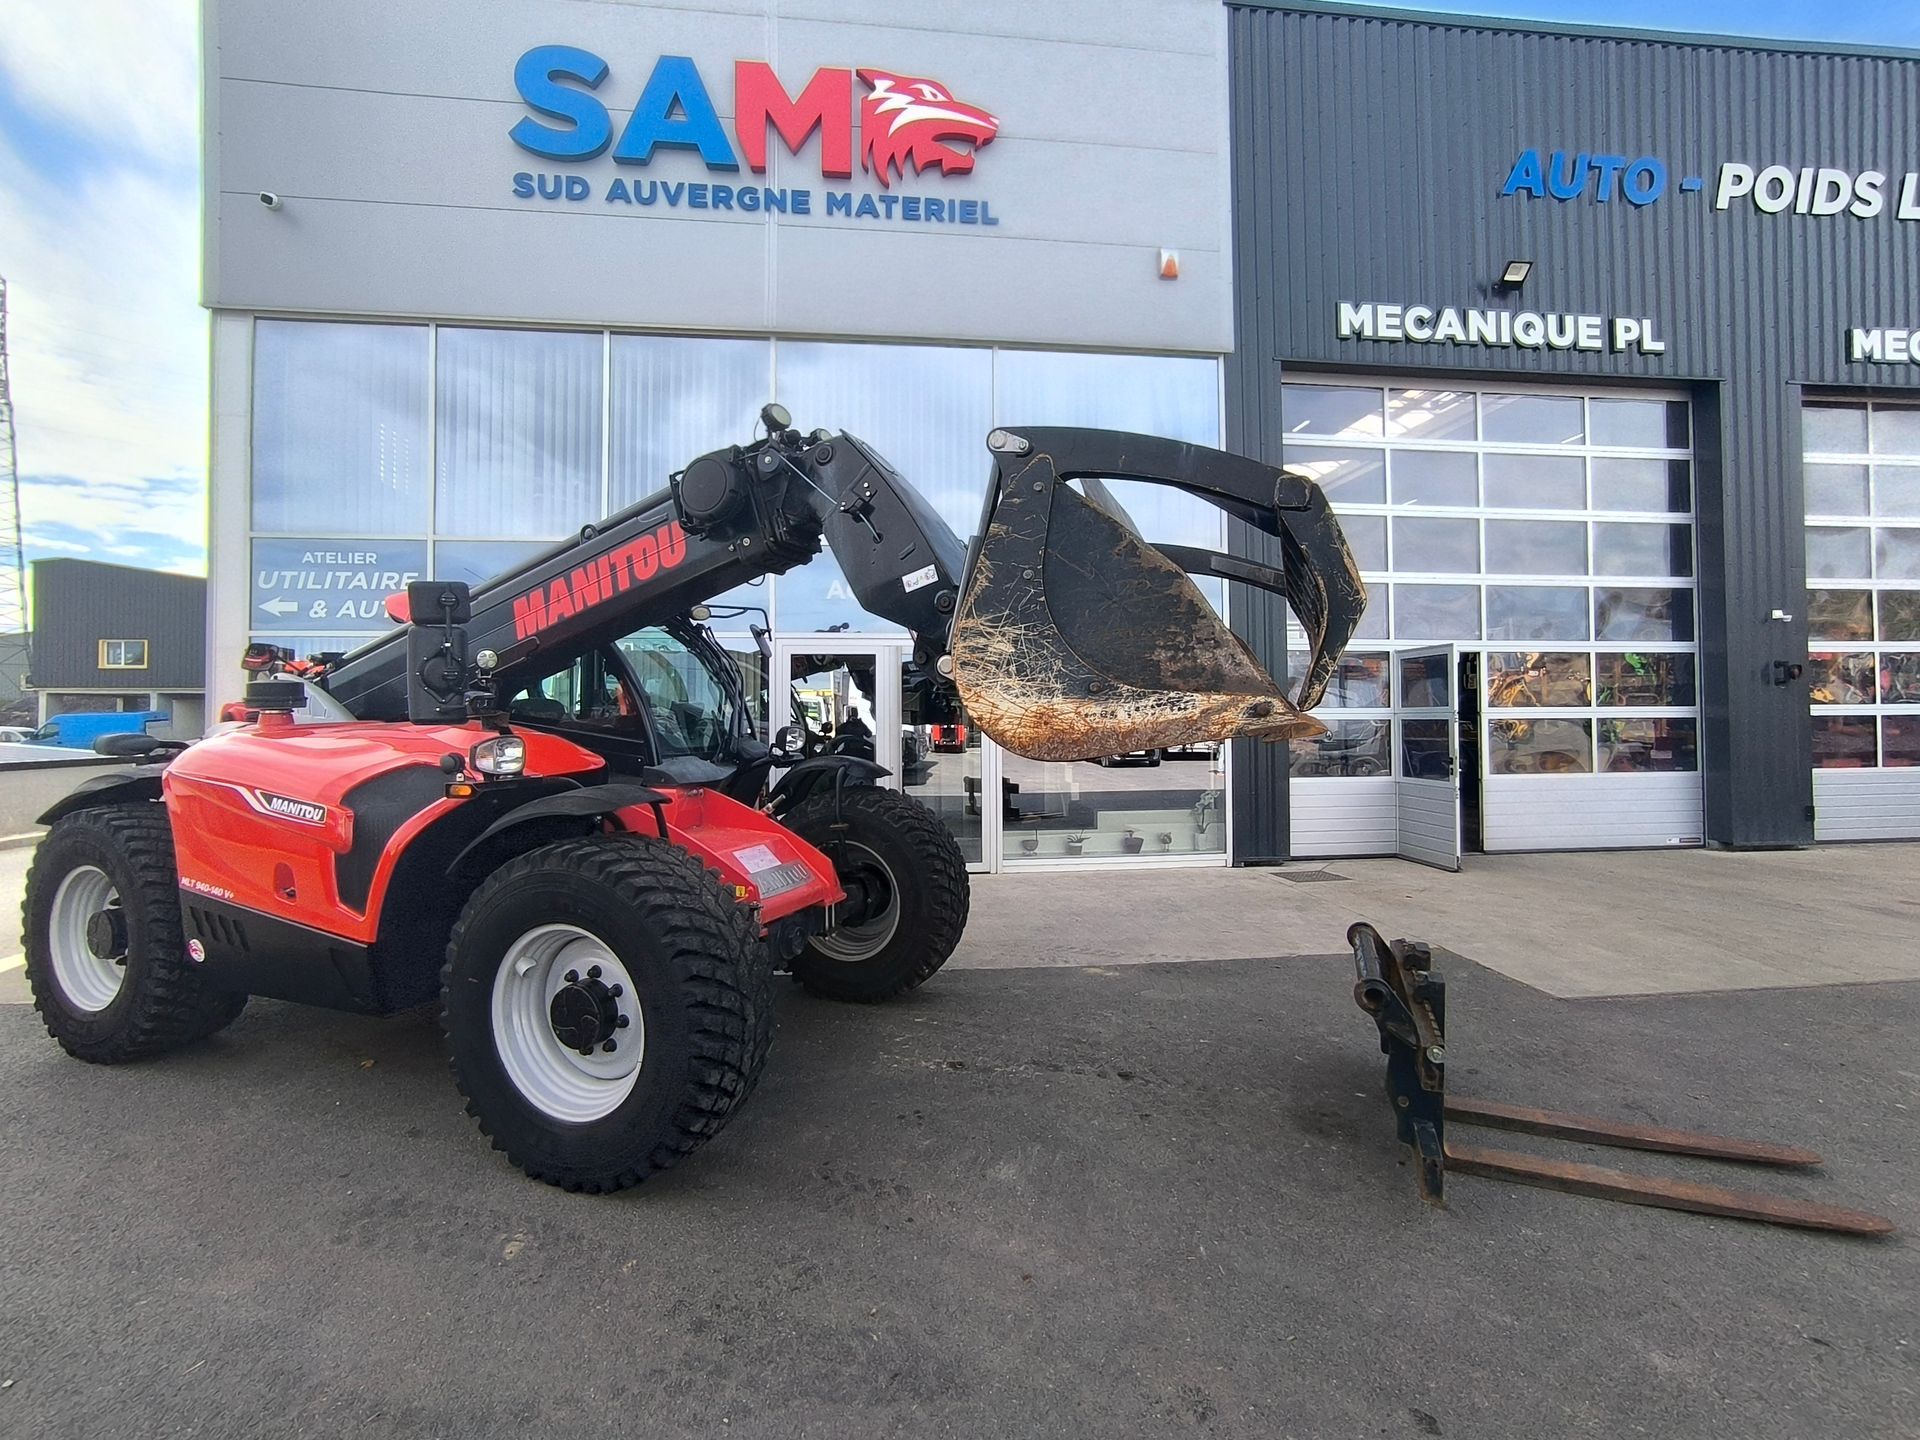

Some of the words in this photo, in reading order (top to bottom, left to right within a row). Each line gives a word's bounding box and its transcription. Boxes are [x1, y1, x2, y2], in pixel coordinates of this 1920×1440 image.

[508, 45, 853, 179] SAM
[512, 171, 590, 201] SUD
[606, 177, 812, 215] AUVERGNE
[827, 191, 999, 226] MATERIEL
[1502, 149, 1667, 206] AUTO
[1716, 162, 1886, 219] POIDS
[1339, 301, 1603, 351] MECANIQUE
[1615, 317, 1666, 354] PL
[302, 551, 377, 565] ATELIER
[513, 520, 687, 641] MANITOU
[308, 599, 328, 619] &
[270, 797, 323, 821] MANITOU
